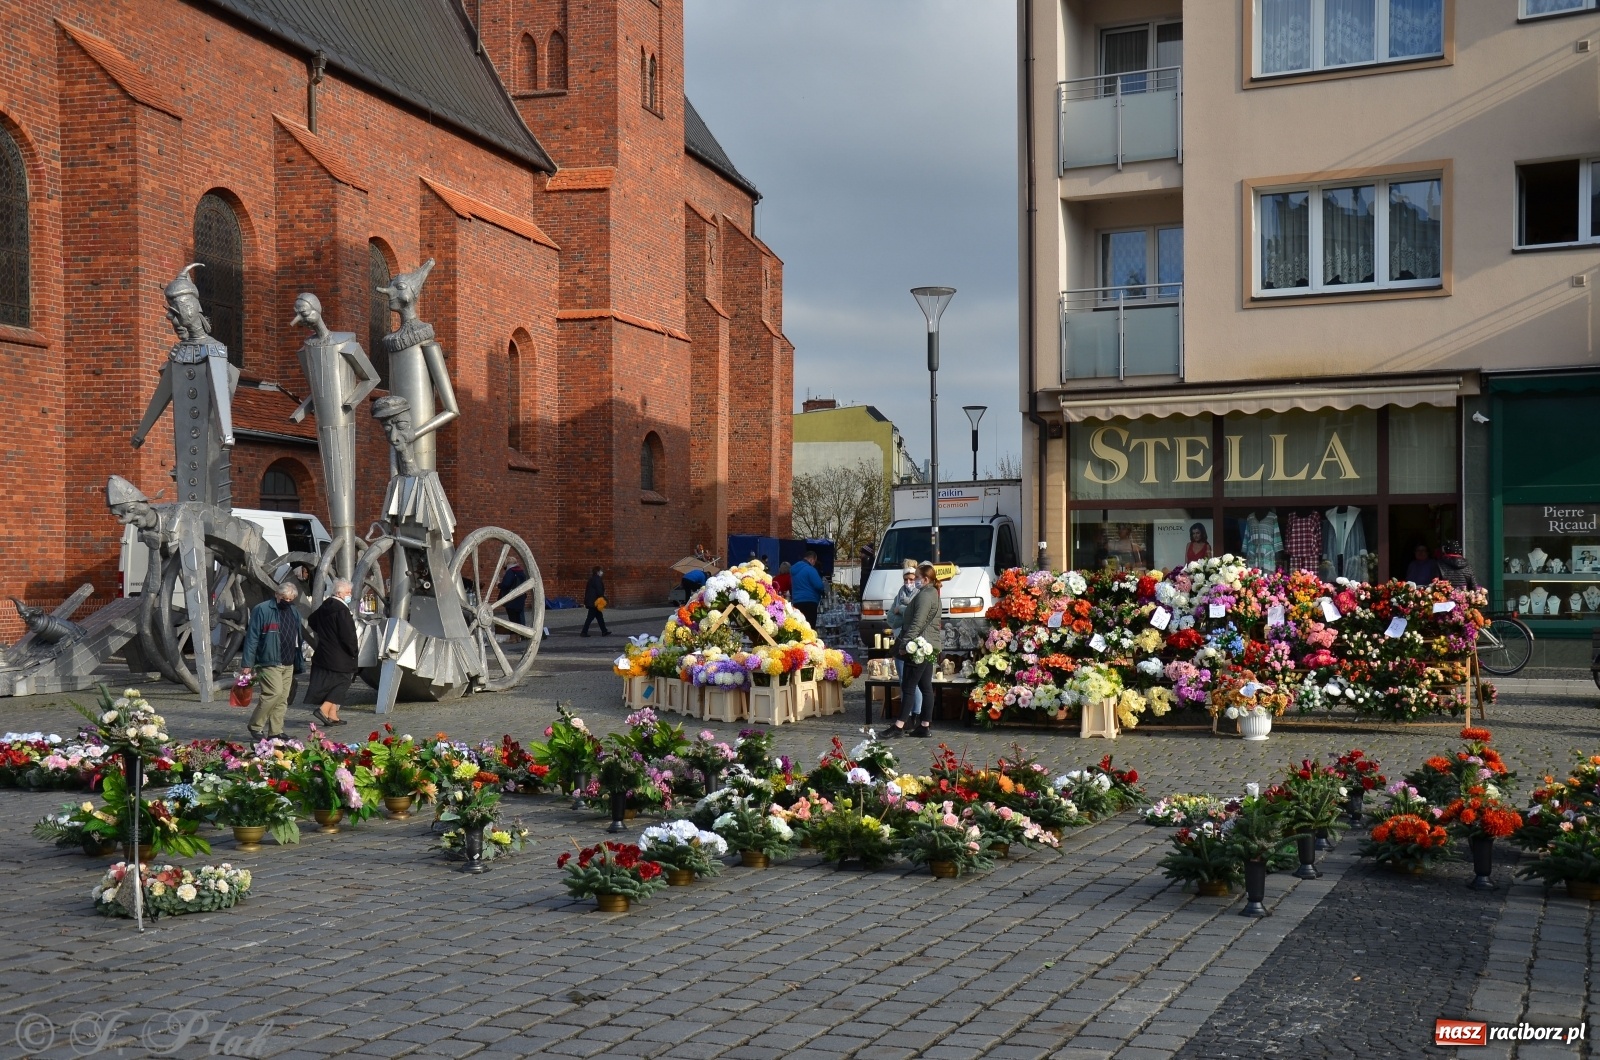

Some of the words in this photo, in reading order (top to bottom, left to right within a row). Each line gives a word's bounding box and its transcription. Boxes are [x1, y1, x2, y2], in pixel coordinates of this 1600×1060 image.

[1083, 426, 1360, 484] STELLA
[938, 489, 963, 497] raikin
[1543, 506, 1585, 518] Pierre
[1548, 513, 1597, 534] Ricaud
